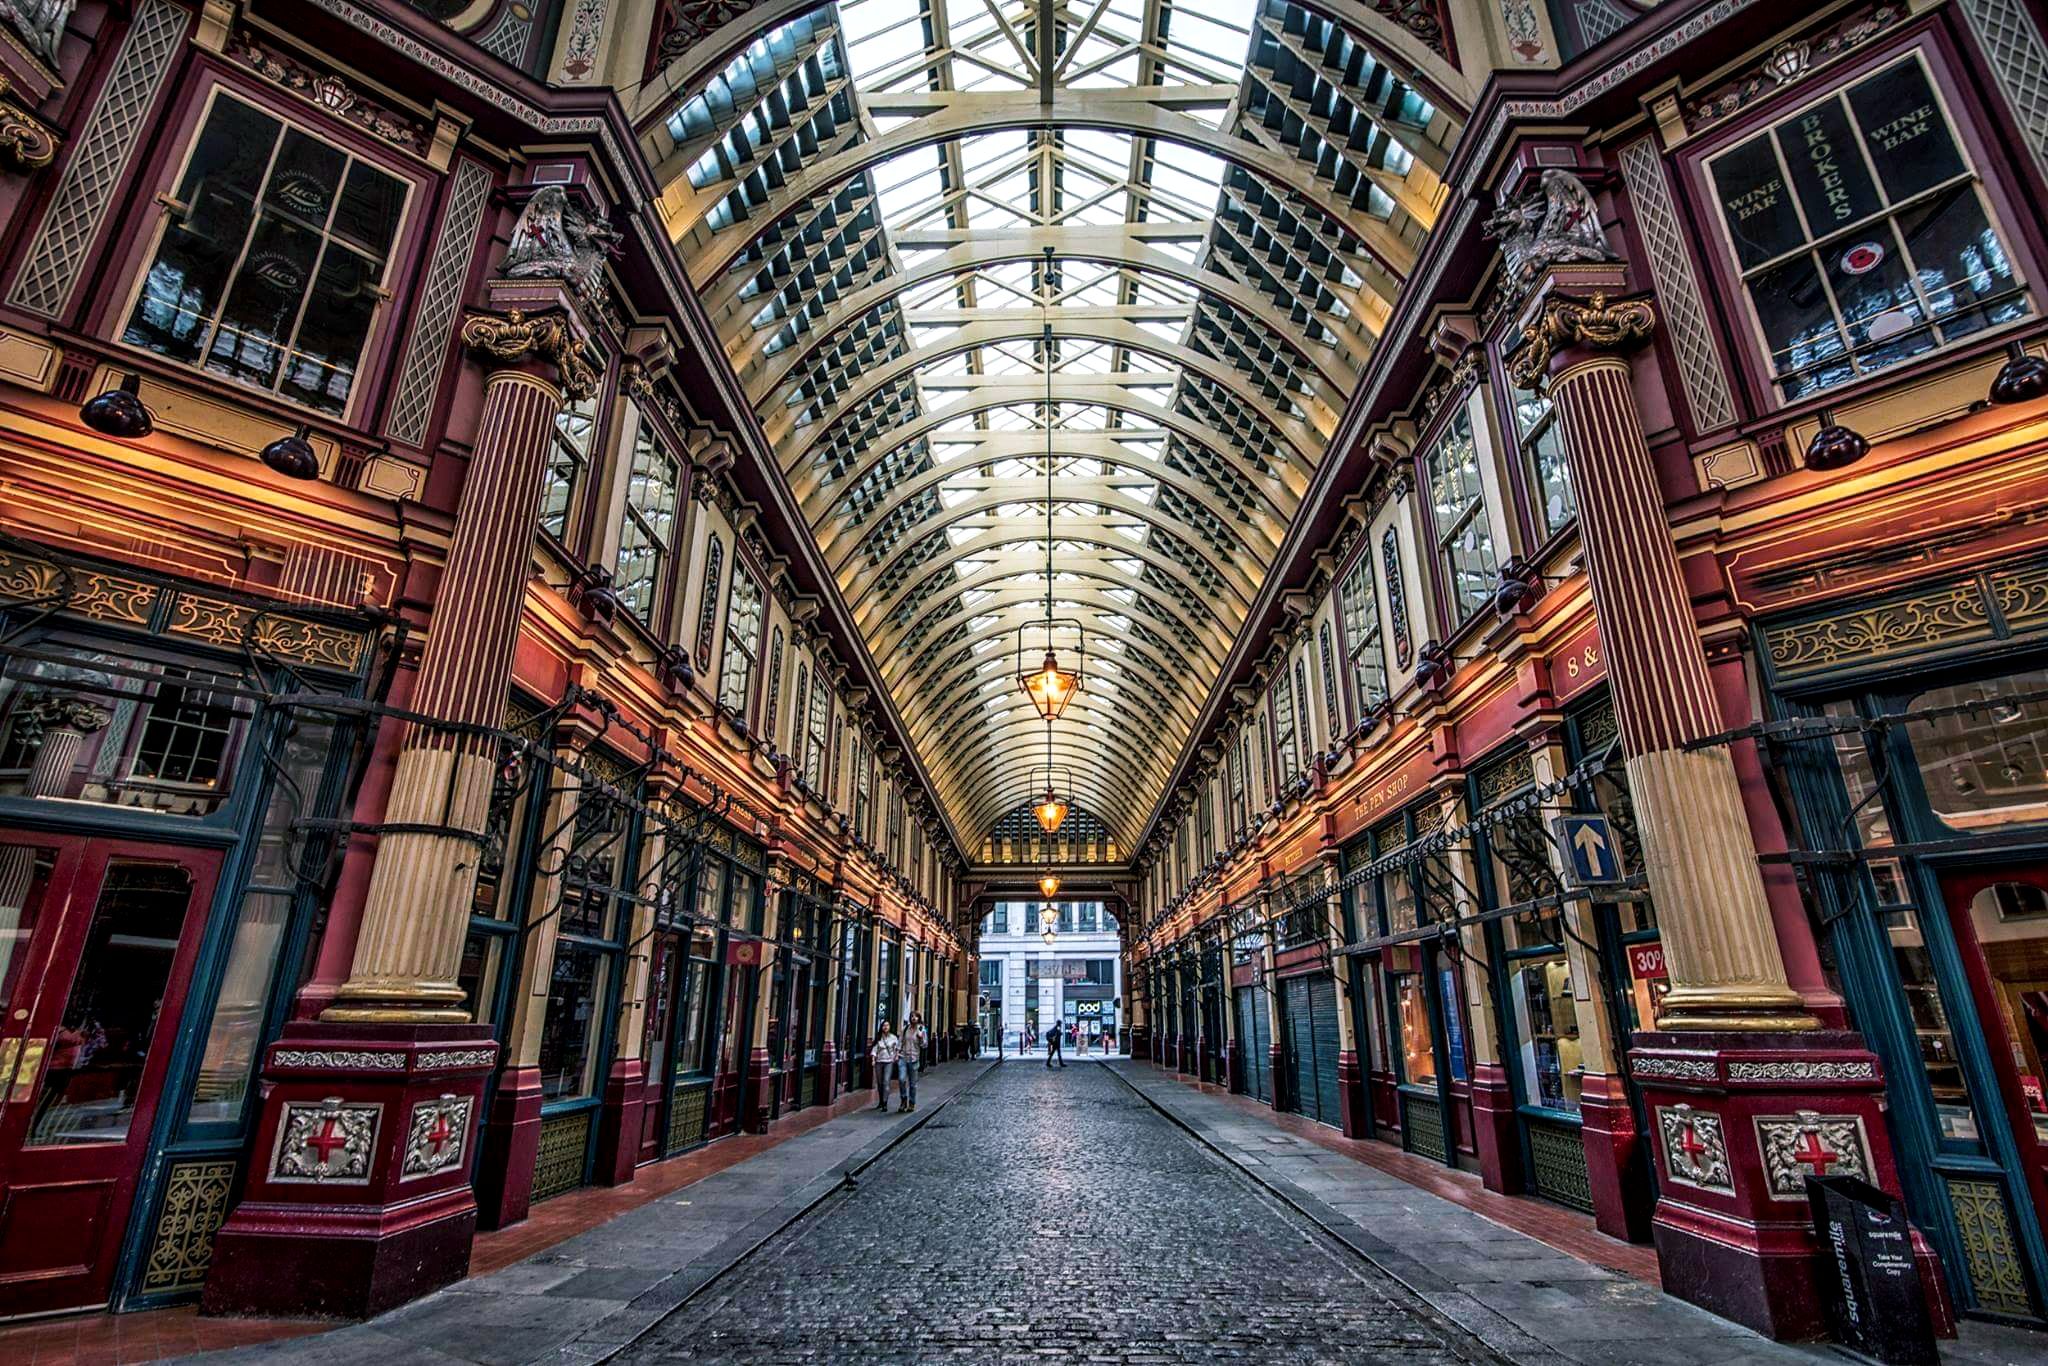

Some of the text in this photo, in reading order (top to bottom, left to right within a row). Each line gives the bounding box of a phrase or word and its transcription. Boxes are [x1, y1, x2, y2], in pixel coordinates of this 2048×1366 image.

[1869, 104, 1934, 142] WINE
[1882, 121, 1931, 151] BAR
[1801, 114, 1852, 221] BROKERS
[1727, 179, 1782, 212] WINE
[1738, 195, 1778, 221] BAR
[1583, 645, 1599, 668] &
[1354, 774, 1408, 821] THE PEN SHOP
[1636, 950, 1665, 972] 30%
[1078, 1001, 1100, 1014] pod
[1872, 1260, 1911, 1269] Complimentary
[1877, 1253, 1903, 1261] Take Your
[1829, 1220, 1860, 1323] squaremile
[1886, 1268, 1901, 1277] Copy
